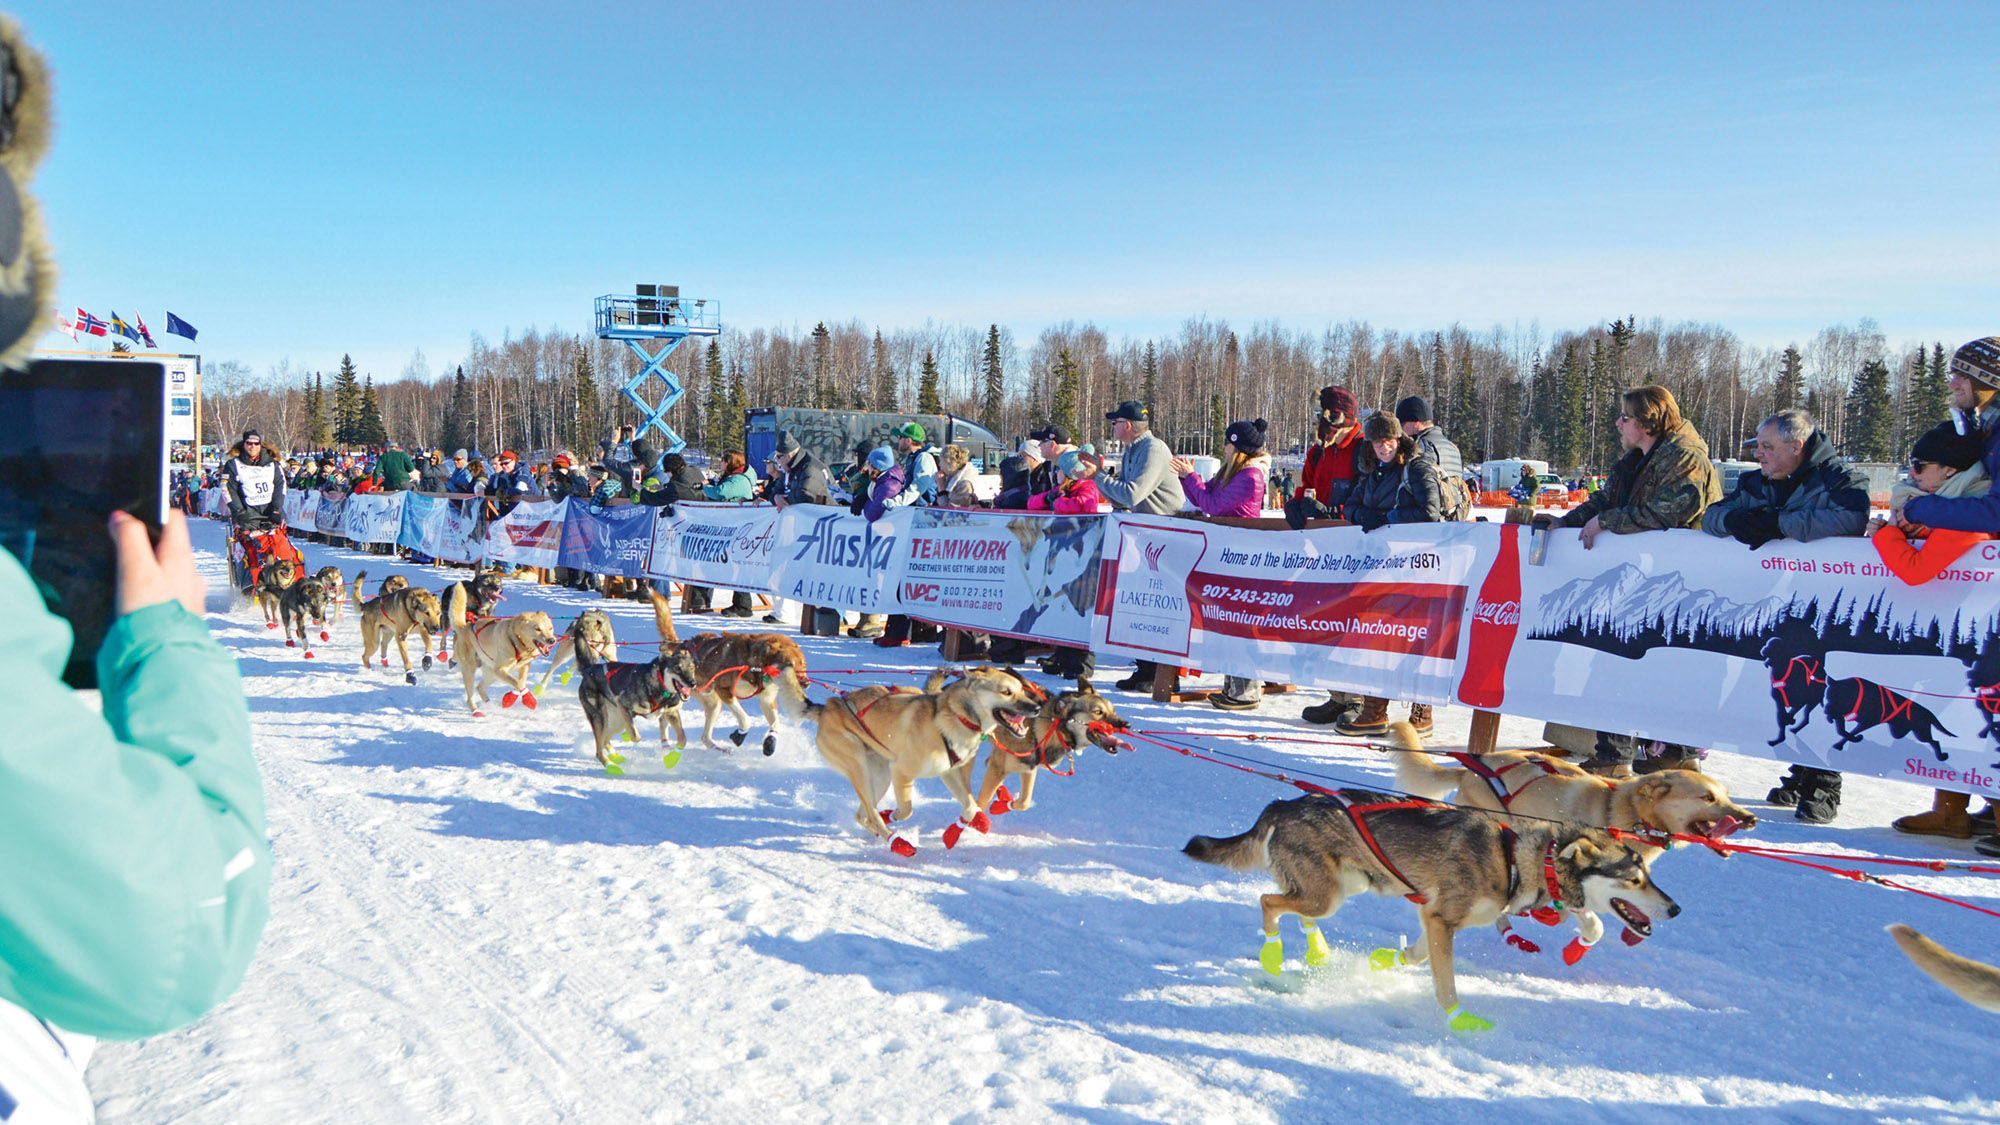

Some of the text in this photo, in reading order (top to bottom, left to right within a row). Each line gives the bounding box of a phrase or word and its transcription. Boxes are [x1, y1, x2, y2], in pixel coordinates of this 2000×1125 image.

[255, 482, 269, 494] 50
[680, 535, 730, 564] MUSHERS
[731, 520, 775, 559] PenAi
[793, 512, 896, 578] Alaska
[911, 538, 1012, 561] TEAMWORK
[908, 563, 1005, 575] TOGETHER WE GET THE JOB DONE
[1220, 547, 1440, 574] Home of the Iditarod Sled Dog Race since 1987!
[1761, 557, 1995, 582] official soft drin onsor
[793, 579, 880, 608] AIRLINES
[905, 582, 940, 602] NAC
[943, 586, 960, 596] 800
[1149, 578, 1163, 590] THE
[1201, 584, 1294, 606] 907-243-2300
[941, 599, 1003, 612] www.nac.aero
[1120, 590, 1183, 611] LAKEFRONT
[1129, 622, 1170, 635] ANCHORAGE
[1201, 604, 1428, 642] MillenniumHotels.com/Anchorage
[1904, 758, 1993, 788] Share the
